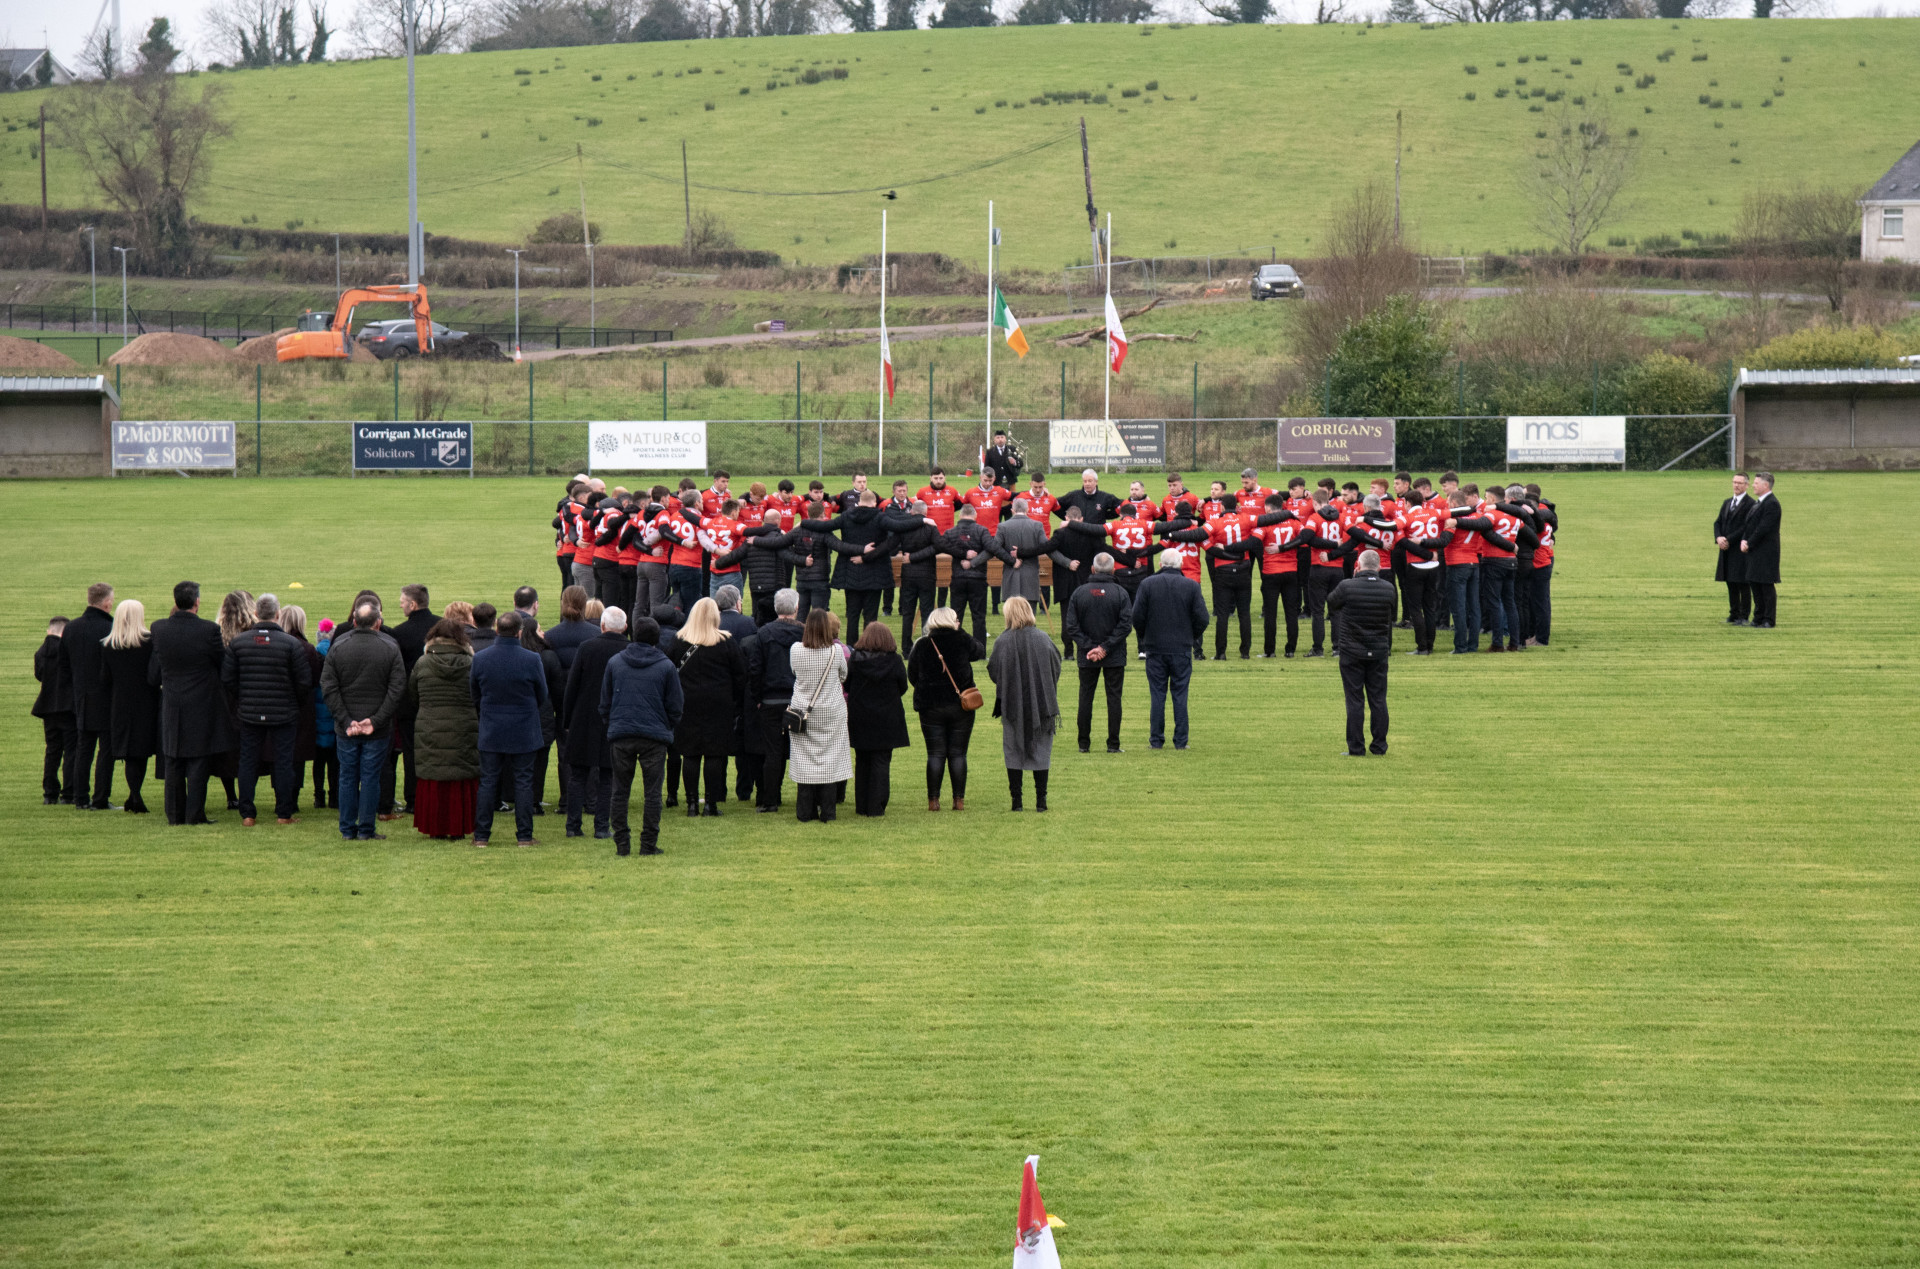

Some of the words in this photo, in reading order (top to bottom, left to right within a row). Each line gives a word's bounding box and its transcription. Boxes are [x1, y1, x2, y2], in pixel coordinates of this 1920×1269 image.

[118, 426, 230, 442] P.McDERMOTT
[360, 428, 411, 441] Corrigan
[414, 428, 467, 438] McGrade
[1054, 425, 1113, 439] PREMIER
[1291, 424, 1382, 437] CORRIGAN'S
[1526, 422, 1579, 440] mas
[1064, 441, 1120, 452] interiors
[1324, 440, 1347, 448] BAR
[146, 447, 158, 464] &
[163, 447, 202, 463] SONS
[364, 448, 415, 458] Solicitors
[1322, 454, 1350, 462] Trillick
[671, 520, 694, 541] 29
[1224, 523, 1242, 545] 11
[1272, 526, 1293, 545] 17
[1321, 521, 1341, 542] 18
[1410, 517, 1438, 539] 26
[1495, 518, 1519, 538] 24
[706, 528, 733, 551] 23
[1115, 527, 1146, 549] 33
